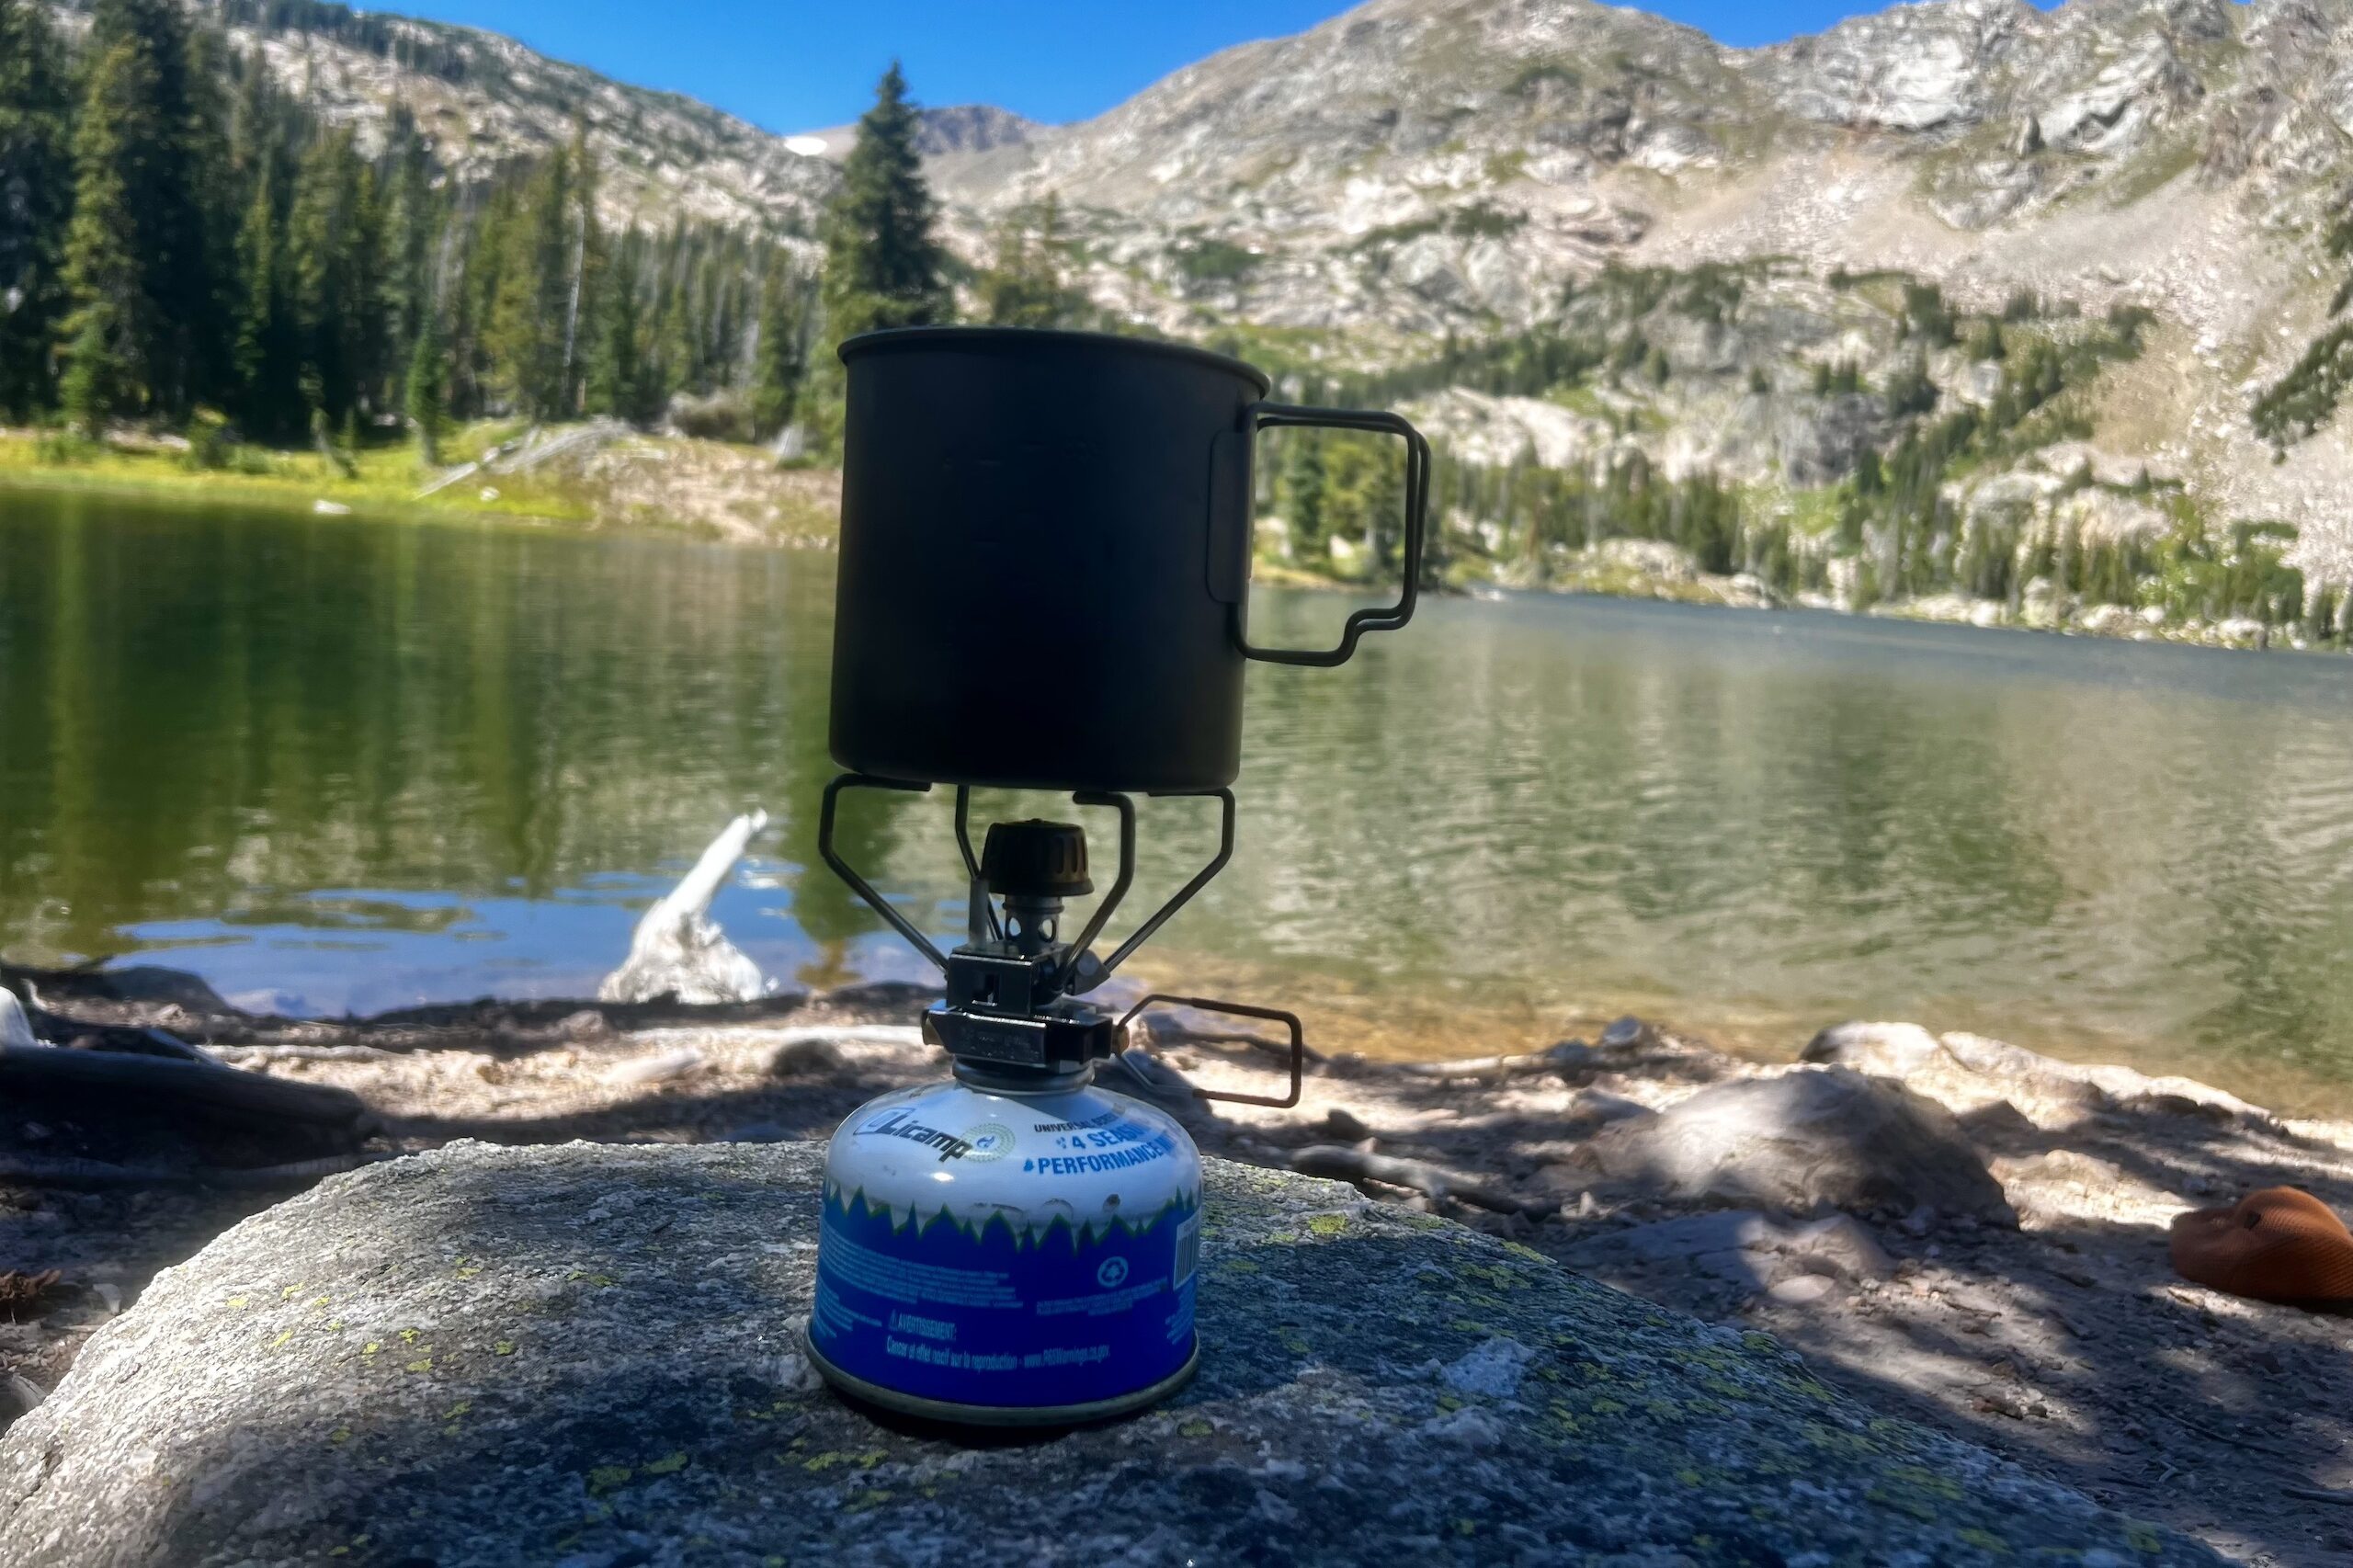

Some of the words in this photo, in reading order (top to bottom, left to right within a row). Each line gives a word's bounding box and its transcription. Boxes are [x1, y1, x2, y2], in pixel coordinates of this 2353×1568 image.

[1072, 1135, 1086, 1149] 4
[1038, 1142, 1164, 1176] PERFORMANCE
[972, 1351, 1017, 1374] reproduction
